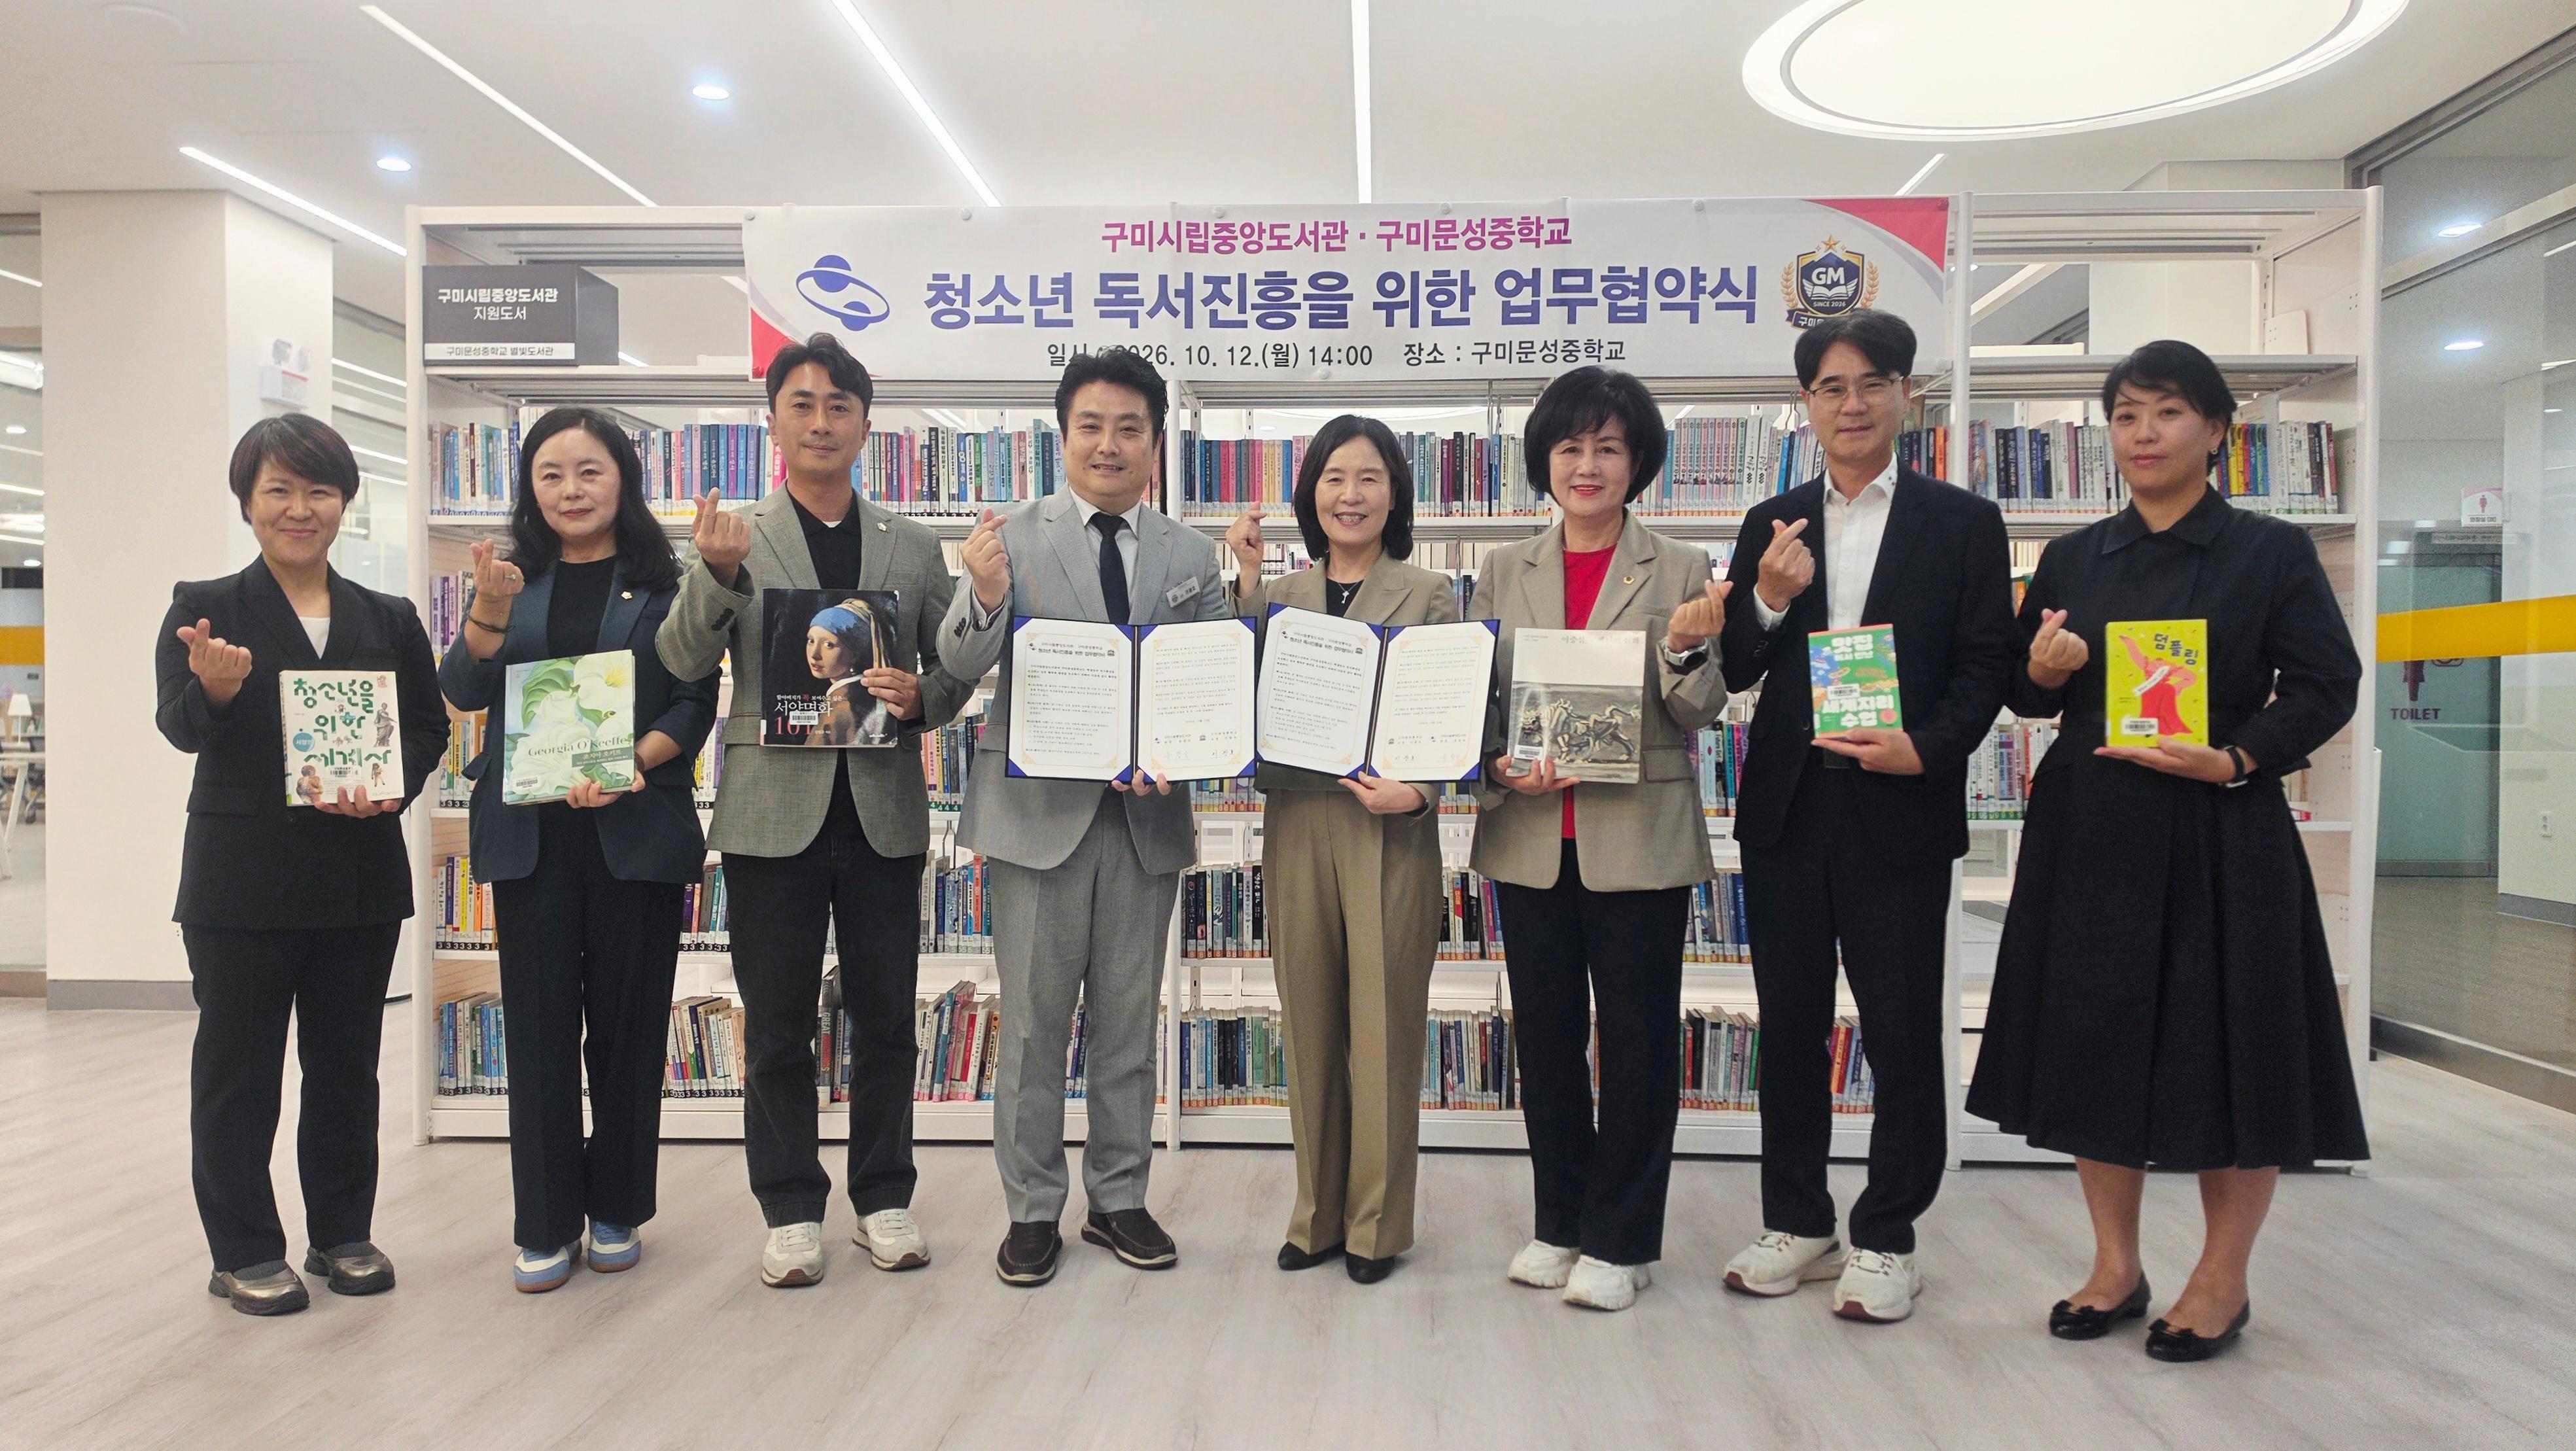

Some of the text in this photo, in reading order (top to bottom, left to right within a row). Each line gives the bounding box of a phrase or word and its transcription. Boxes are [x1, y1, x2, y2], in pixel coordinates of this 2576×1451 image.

[1102, 220, 1348, 254] 구미시립중앙도서관
[1376, 217, 1571, 252] 구미문성중학교
[1811, 267, 1845, 285] GM
[438, 288, 558, 304] 구미시립중앙도서관
[924, 265, 1756, 330] 청소년 독서진흥을 위한 업무협약식
[474, 306, 527, 321] 지원도서
[446, 347, 554, 357] 구미문성중학교 별빛도서관
[1185, 345, 1217, 366] 10.
[1227, 342, 1299, 368] 12.(월)
[1309, 345, 1372, 366] 14:00
[1404, 342, 1446, 366] 장소
[1472, 338, 1626, 366] 구미문성중학교
[775, 701, 833, 716] 서양명화
[2391, 708, 2441, 720] TOILET
[528, 743, 574, 758] Georgia
